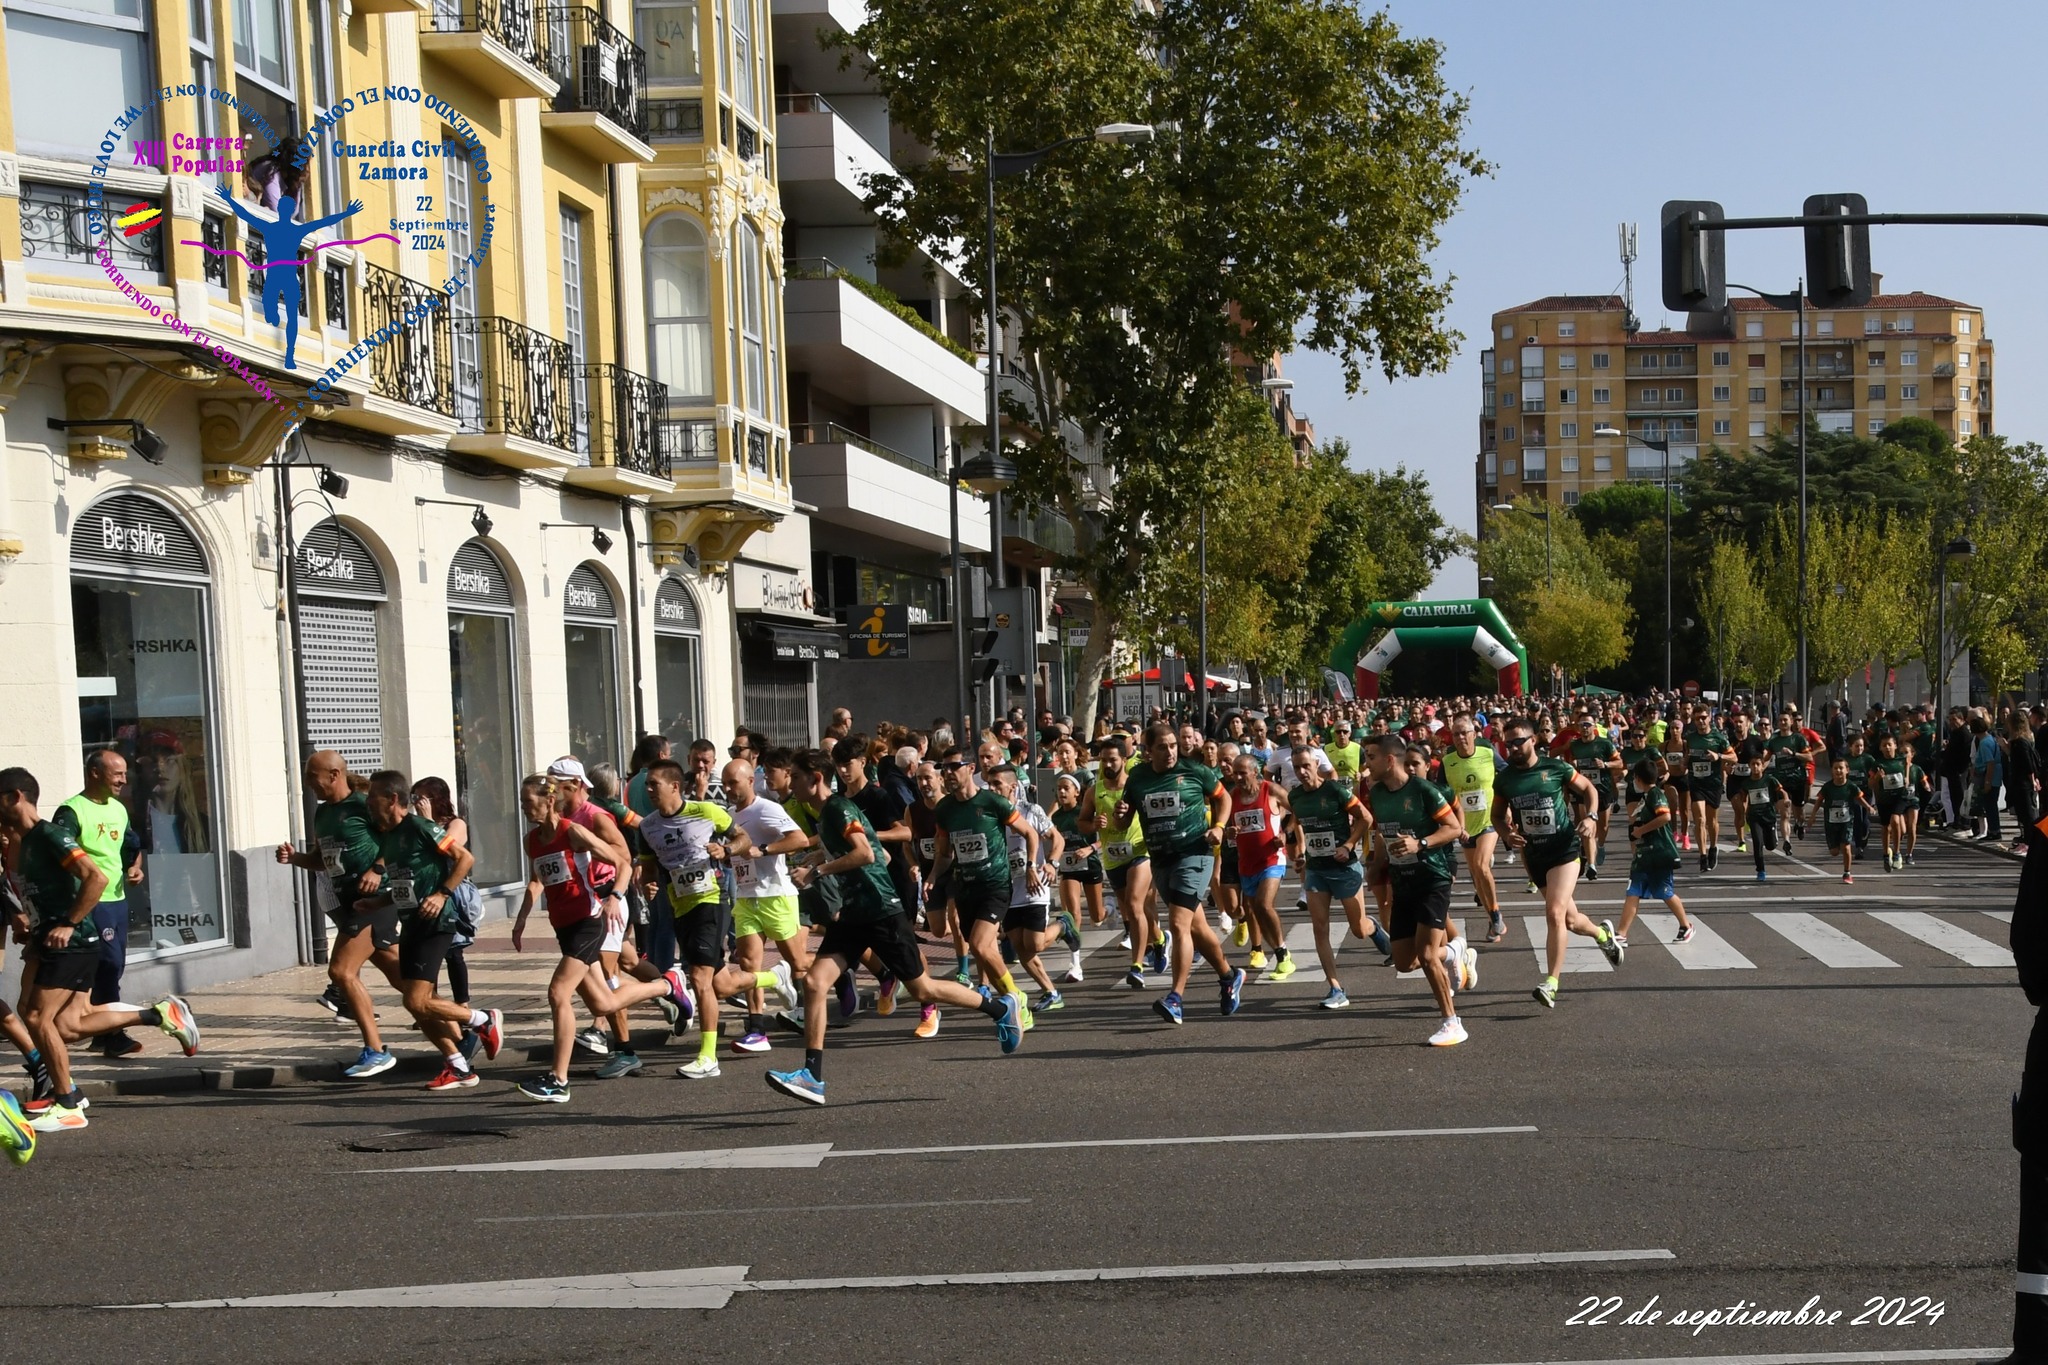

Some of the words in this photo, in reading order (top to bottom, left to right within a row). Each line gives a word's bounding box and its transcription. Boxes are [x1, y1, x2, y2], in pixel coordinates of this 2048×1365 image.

[102, 516, 166, 556] Bershka
[454, 566, 490, 594] Bershka
[568, 584, 597, 607] Bershka
[660, 598, 684, 619] Bershka
[1403, 606, 1432, 617] CAJA
[1433, 604, 1475, 616] RURAL
[1150, 797, 1175, 808] 615
[1466, 796, 1479, 804] 67
[1240, 815, 1258, 826] 873
[1526, 815, 1550, 826] 380
[959, 841, 983, 853] 522
[1308, 838, 1331, 848] 486
[1107, 846, 1128, 856] 611
[540, 861, 560, 876] 836
[677, 870, 705, 885] 409
